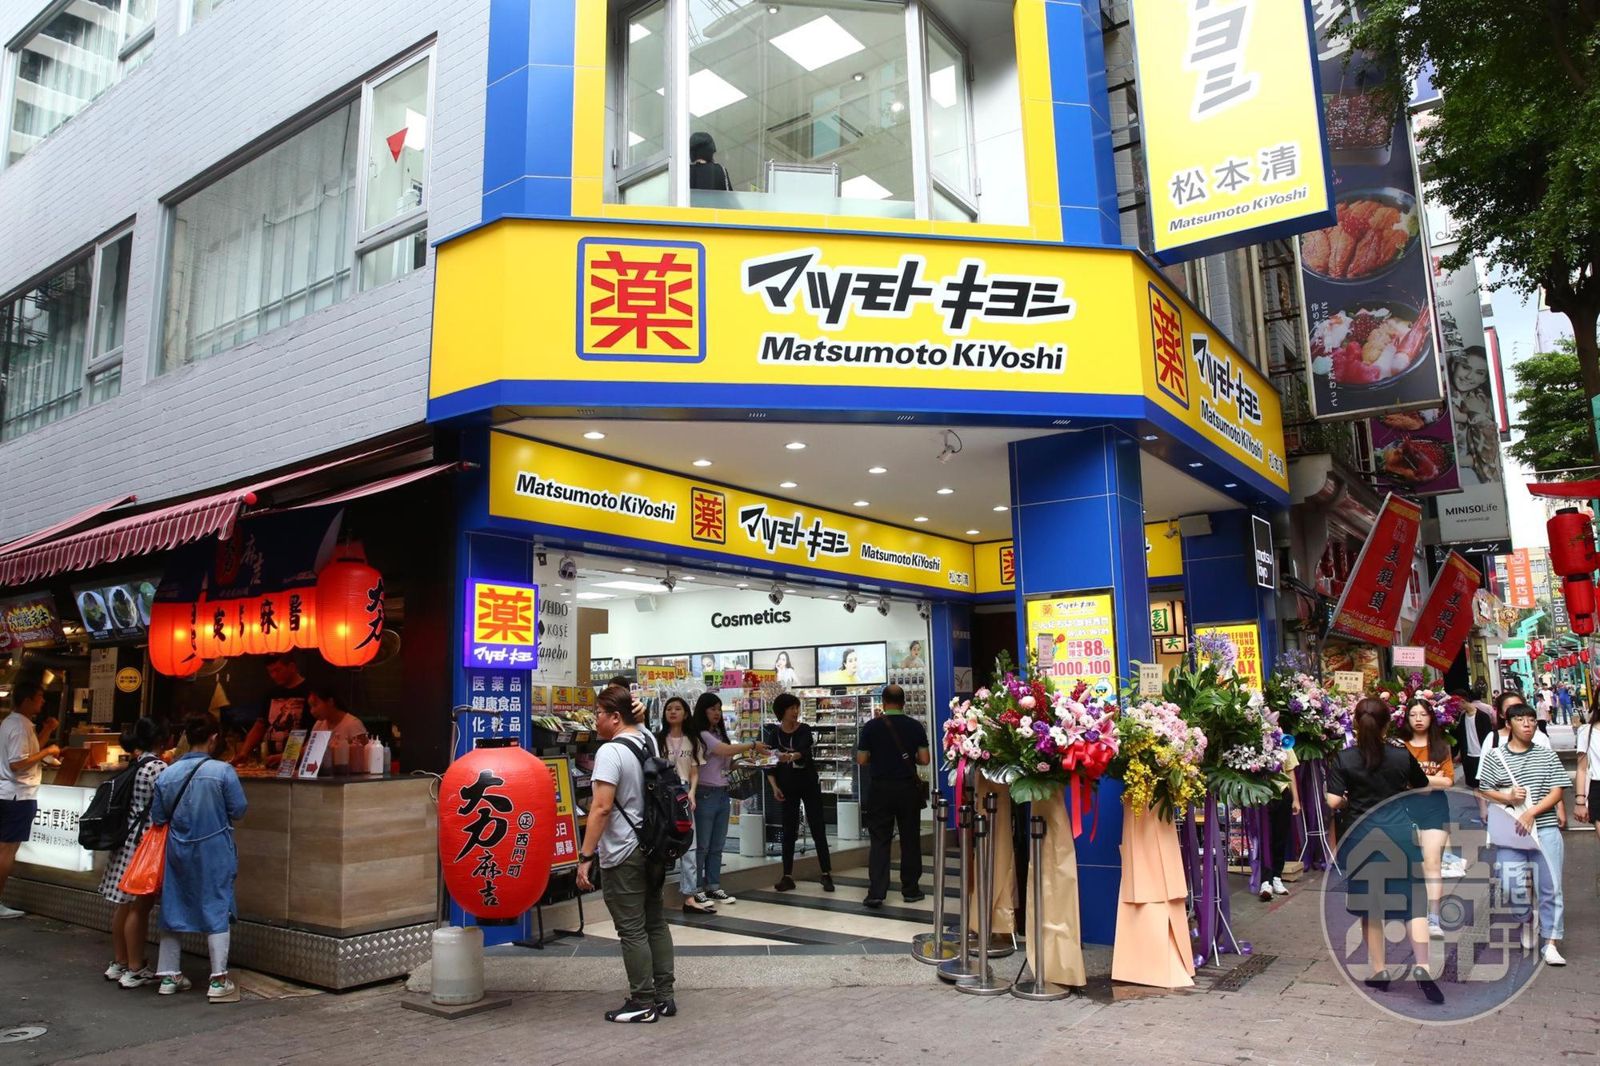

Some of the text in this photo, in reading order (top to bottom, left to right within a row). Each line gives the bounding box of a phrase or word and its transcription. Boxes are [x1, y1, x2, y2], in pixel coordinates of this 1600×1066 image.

[1191, 0, 1251, 113] ヨシ
[1172, 145, 1297, 205] 松本清
[1169, 187, 1307, 231] Matsumoto KiYoshi
[590, 249, 693, 350] 薬
[761, 336, 1064, 371] Matsumoto KiYoshi
[1153, 297, 1186, 398] 薬
[1201, 399, 1263, 460] Matsumoto KiYoshi
[516, 473, 676, 521] Matsumoto KiYoshi
[694, 493, 723, 539] 薬
[861, 544, 940, 571] Matsumoto KiYoshi
[948, 572, 969, 586] 松本清
[478, 587, 531, 643] 薬
[711, 607, 792, 628] Cosmetics
[1553, 599, 1568, 626] Hotel
[1083, 639, 1103, 657] 88
[472, 675, 522, 692] 医薬品
[1053, 661, 1083, 677] 1000
[472, 695, 522, 712] 健康食品
[472, 716, 521, 733] 化粧品
[507, 832, 530, 878] 西門町
